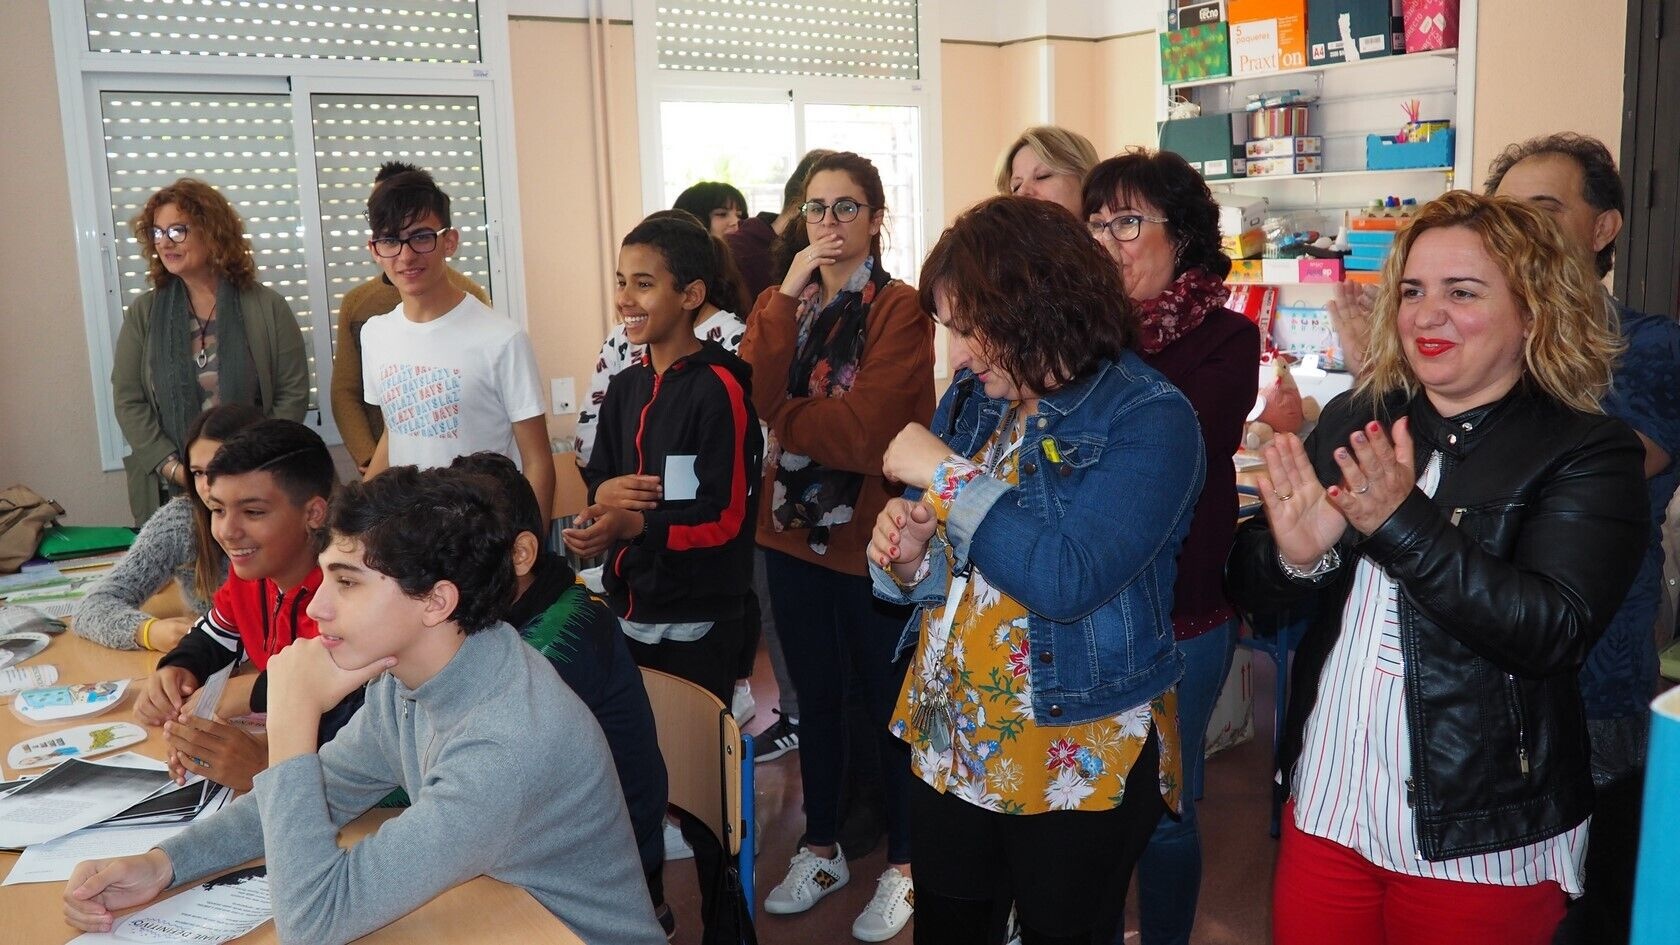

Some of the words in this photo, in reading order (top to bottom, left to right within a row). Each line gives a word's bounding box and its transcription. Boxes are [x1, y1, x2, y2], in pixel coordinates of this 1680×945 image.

[1236, 26, 1242, 36] 5
[1313, 45, 1325, 57] A4
[432, 403, 459, 423] DAYS
